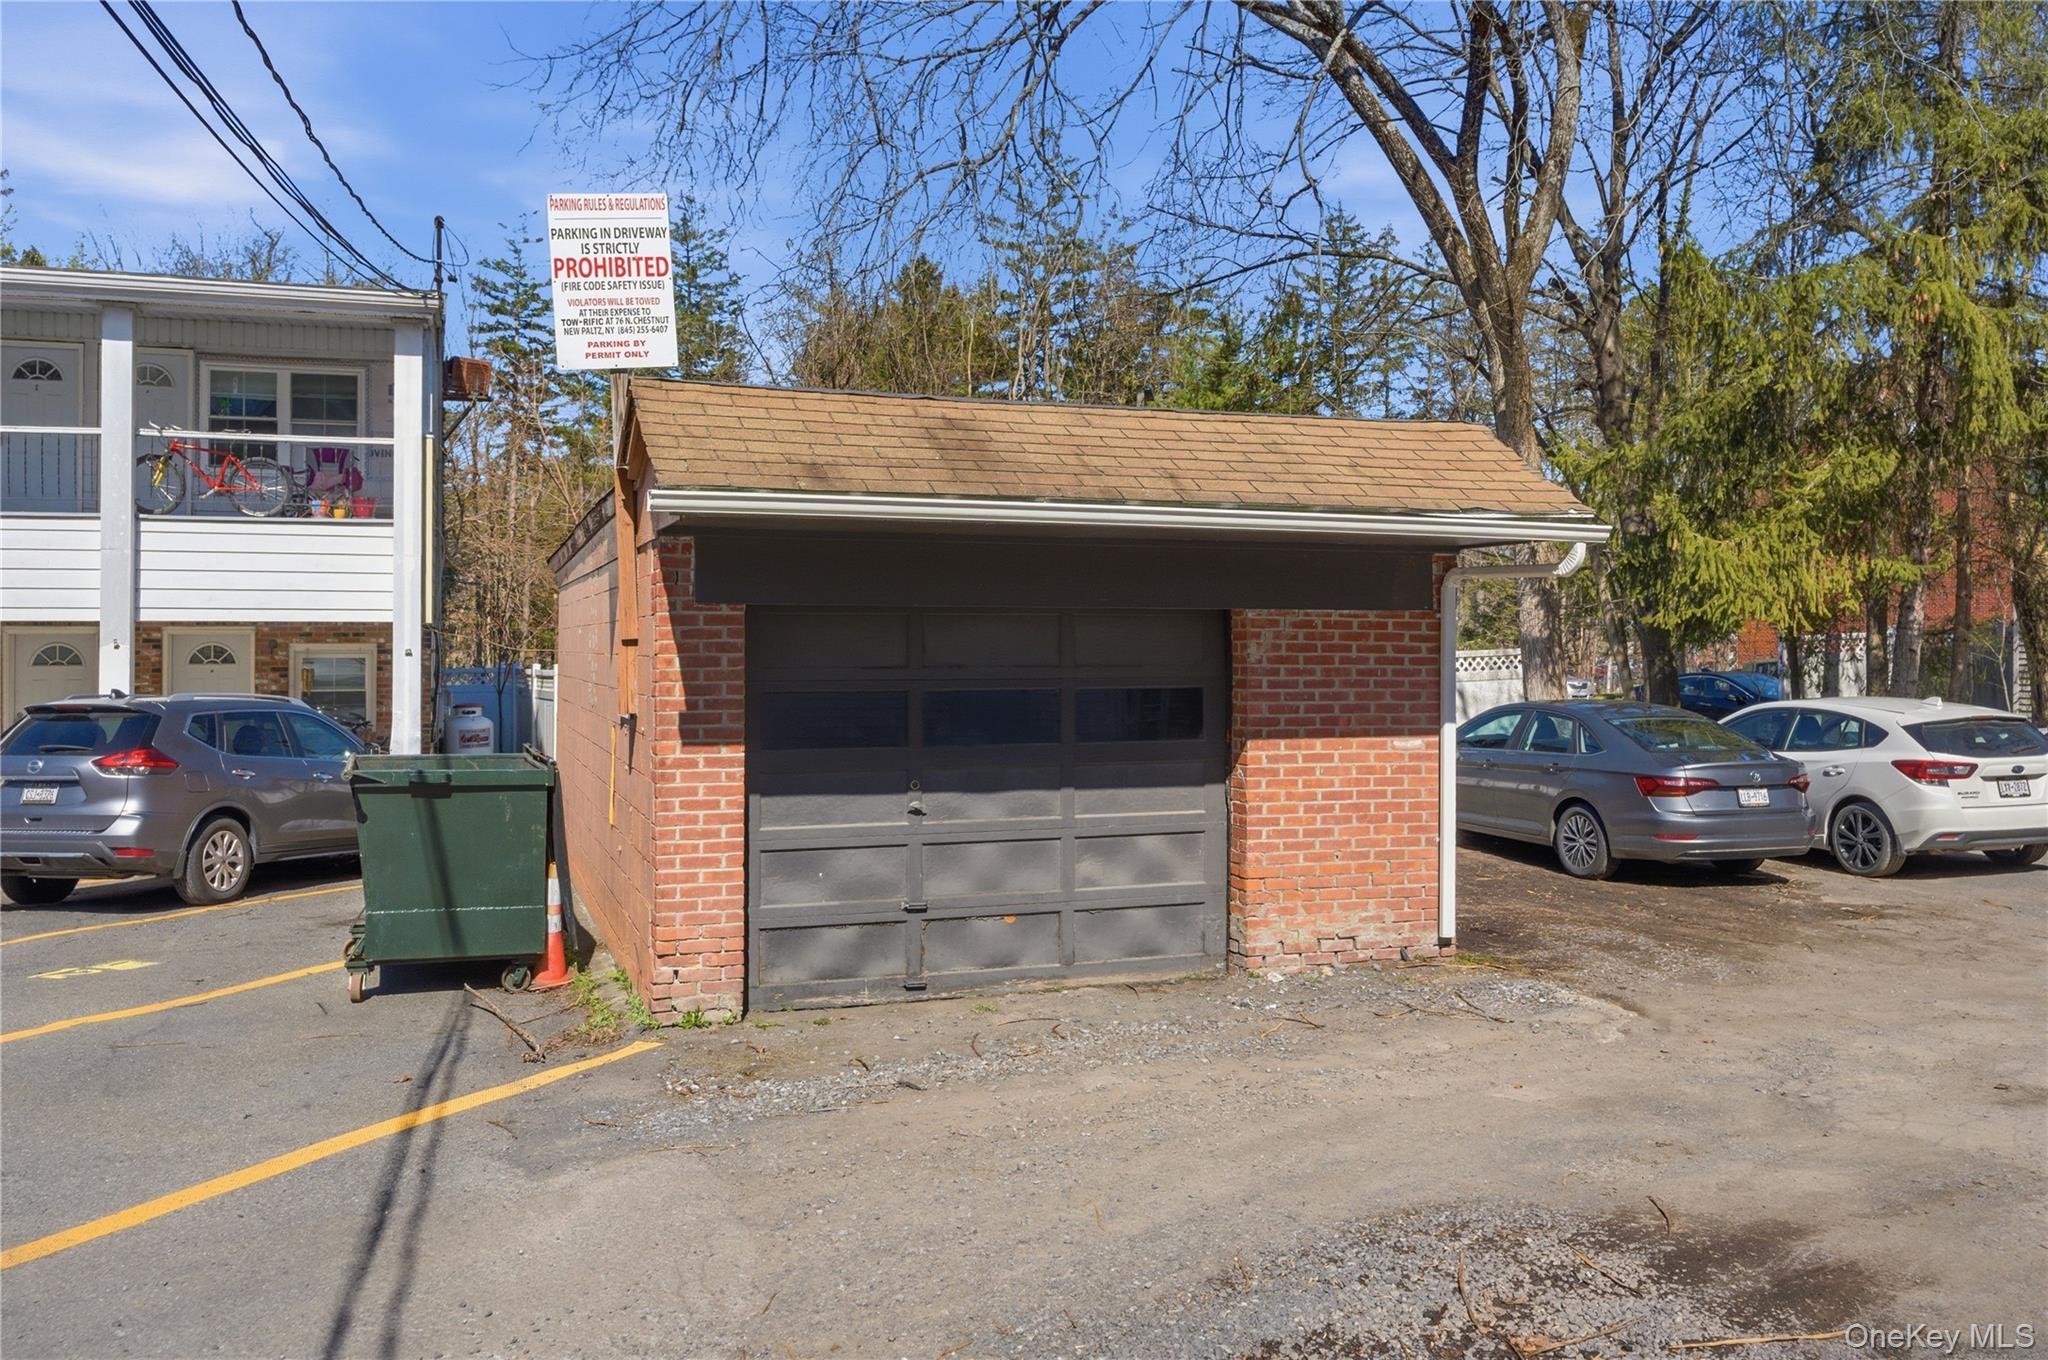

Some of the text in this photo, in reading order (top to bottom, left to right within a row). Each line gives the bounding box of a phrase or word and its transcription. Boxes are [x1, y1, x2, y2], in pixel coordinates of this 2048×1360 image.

[550, 197, 665, 211] PARKING RULES & REGULATIONS
[551, 226, 667, 240] PARKING IN DRIVEWAY
[581, 242, 640, 255] IS STRICTLY
[553, 256, 669, 279] PROHIBITED
[561, 280, 665, 293] (FIRE CODE SAFETY ISSUE)
[567, 297, 661, 307] VIOLATORS WILL BE TOWED
[579, 307, 651, 317] AT THEIR EXPENSE TO
[605, 317, 614, 325] AT
[615, 317, 625, 325] 76
[625, 317, 633, 325] N.
[633, 316, 669, 325] CHESTNUT
[563, 327, 580, 336] NEW
[605, 326, 615, 335] NY
[618, 326, 635, 335] (845)
[636, 325, 668, 335] 255-6407
[587, 340, 631, 348] PARKING
[585, 351, 650, 360] PERMIT ONLY
